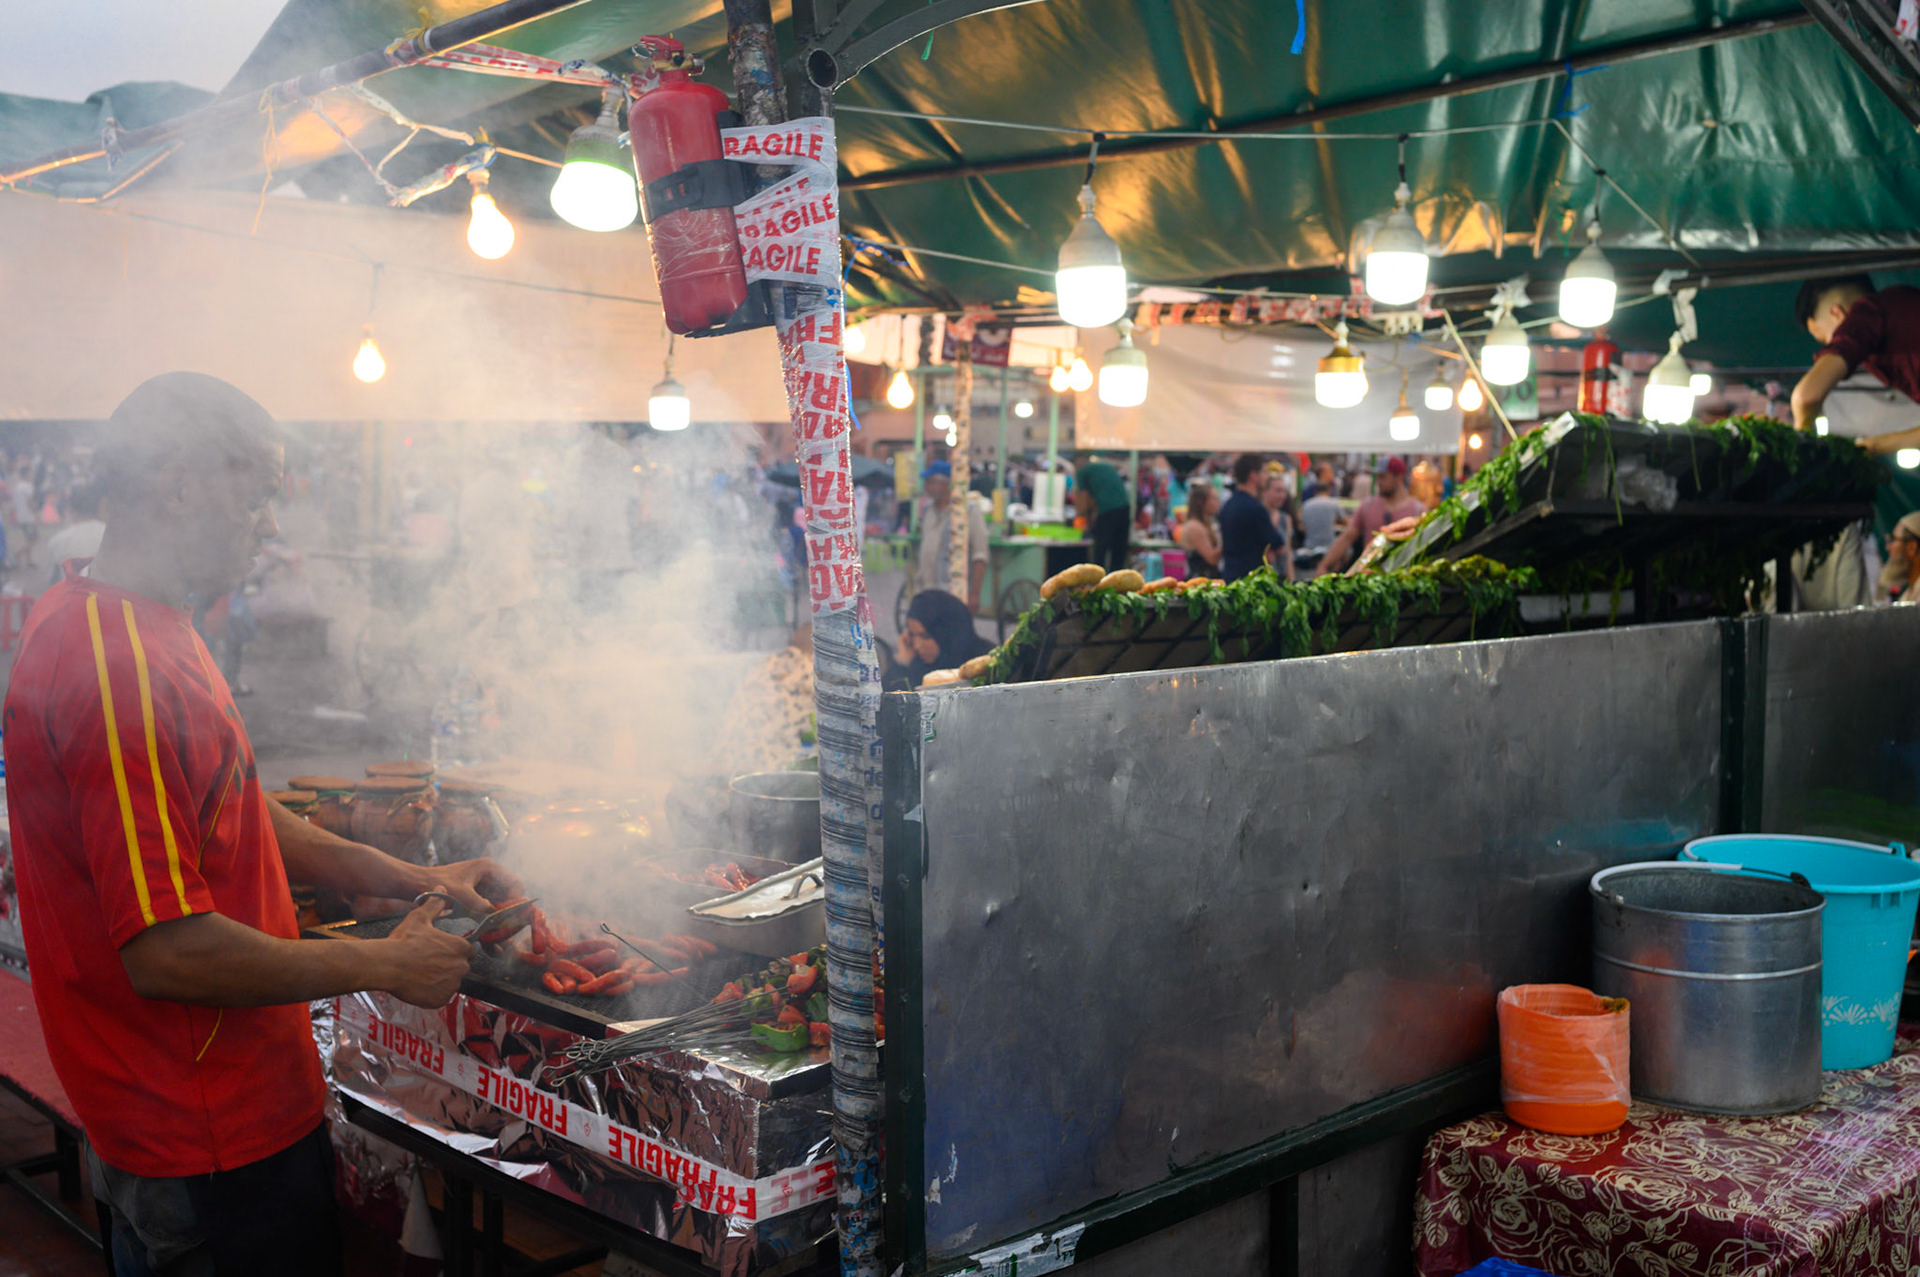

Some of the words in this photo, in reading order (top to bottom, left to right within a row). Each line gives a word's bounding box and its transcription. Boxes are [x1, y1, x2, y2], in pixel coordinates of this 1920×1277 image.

[737, 193, 836, 238] RAGILE
[367, 1013, 445, 1076] FRAGILE
[476, 1065, 568, 1137] FRAGILE
